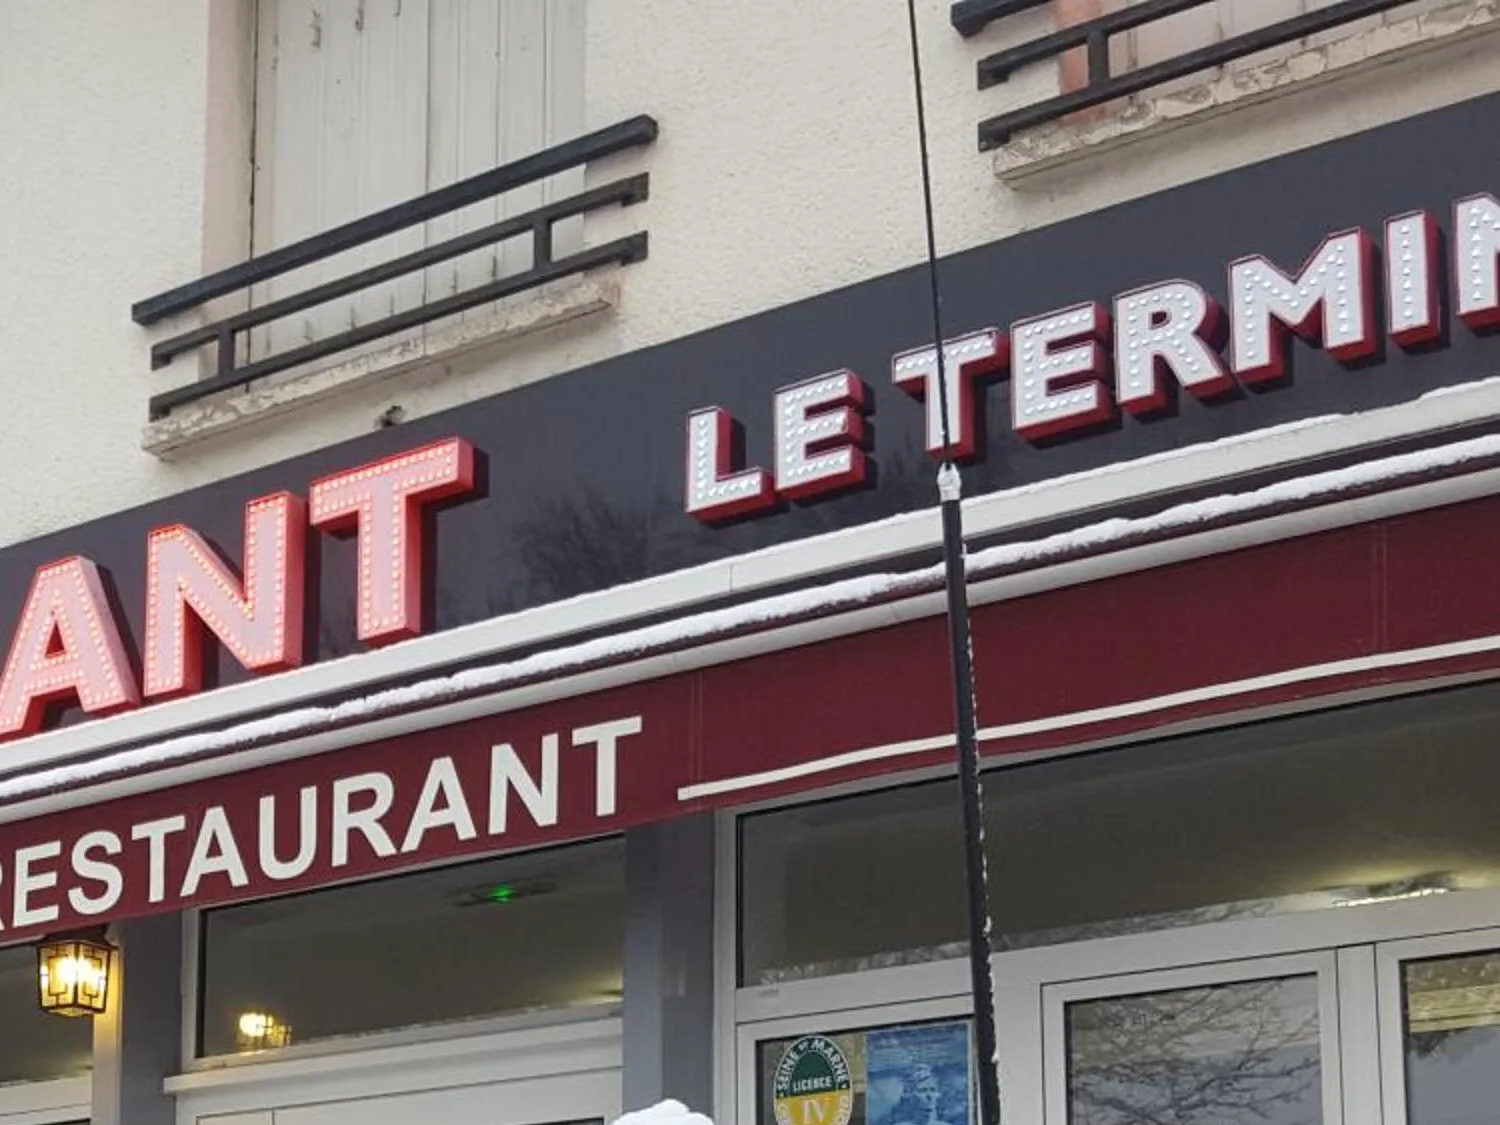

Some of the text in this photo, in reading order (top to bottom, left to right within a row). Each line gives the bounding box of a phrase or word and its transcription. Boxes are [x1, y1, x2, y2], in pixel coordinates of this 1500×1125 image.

[685, 368, 868, 520] LE
[811, 1039, 849, 1083] MARNE
[793, 1077, 833, 1092] LICENCE
[803, 1098, 830, 1125] IV
